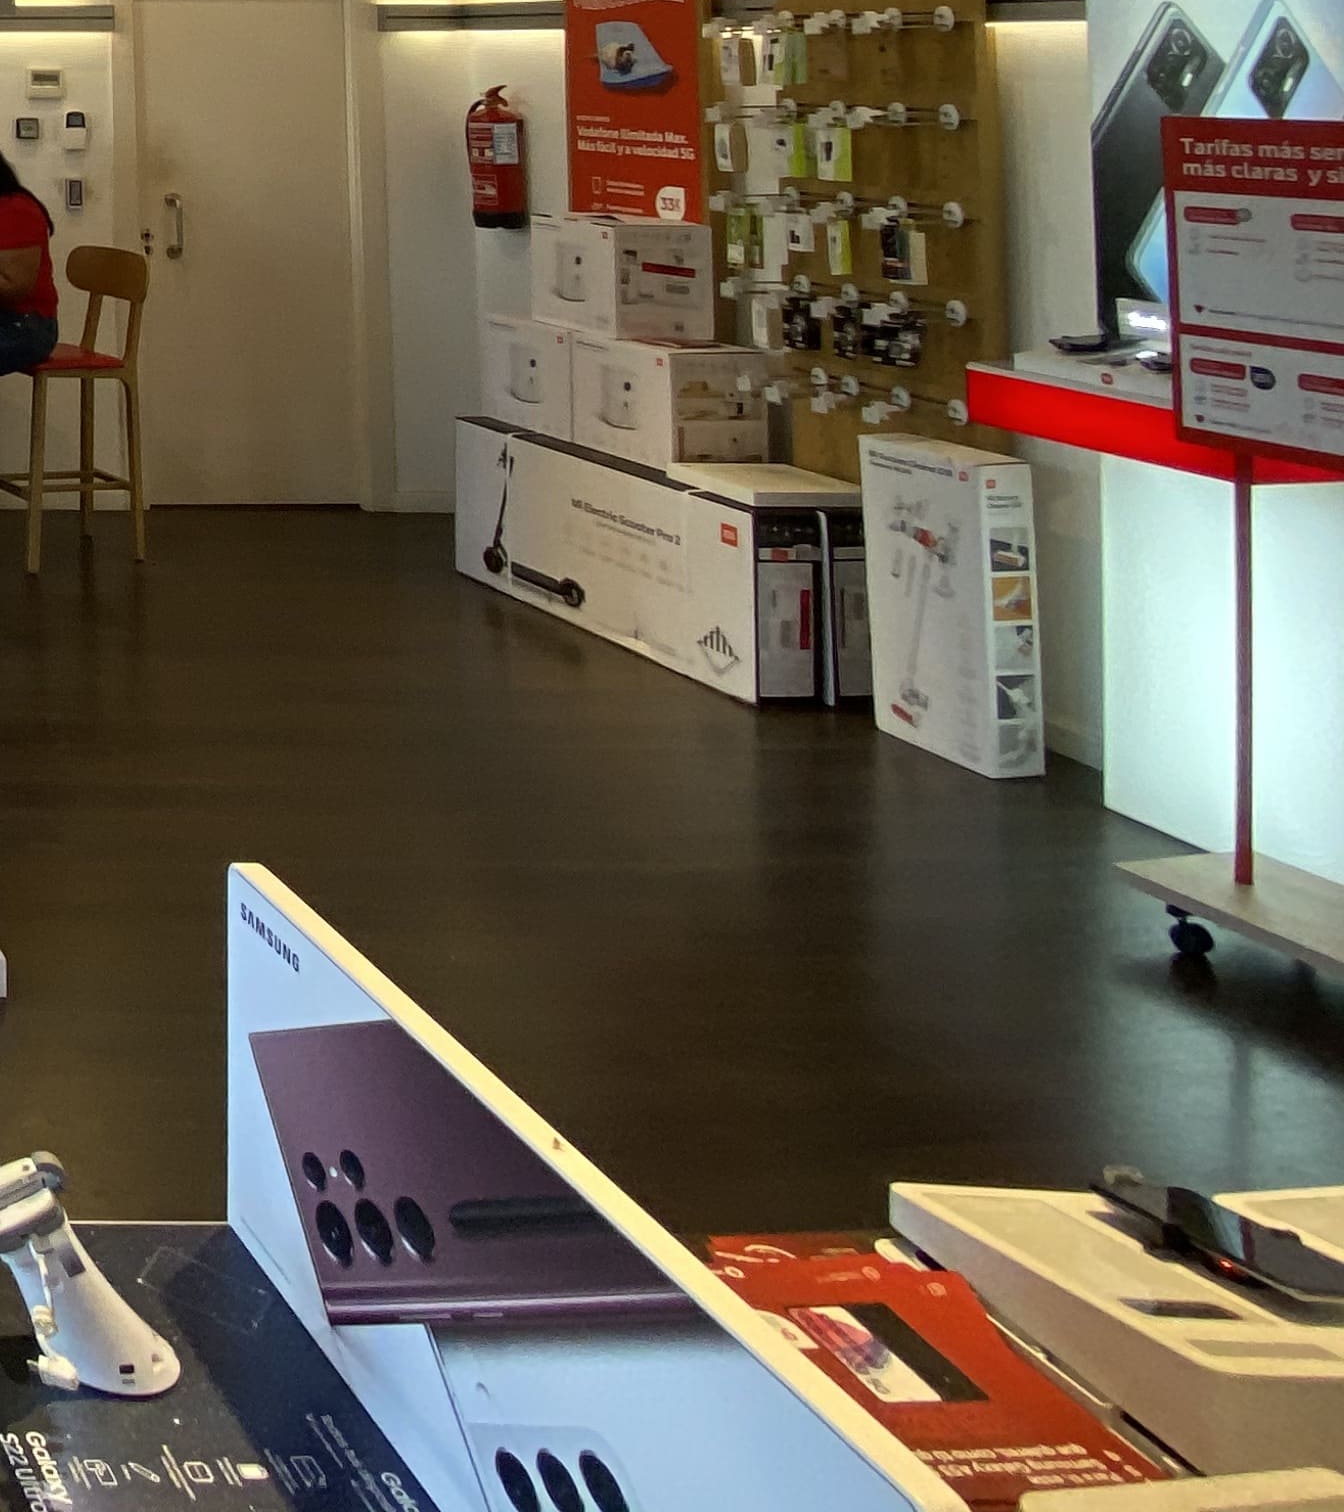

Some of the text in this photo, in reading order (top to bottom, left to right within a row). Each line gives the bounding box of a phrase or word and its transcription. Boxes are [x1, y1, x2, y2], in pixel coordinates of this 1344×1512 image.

[1179, 138, 1254, 157] Tarifas
[1258, 141, 1305, 160] más
[1182, 160, 1226, 177] más
[1231, 164, 1298, 182] claras
[1307, 169, 1322, 186] y
[240, 902, 300, 973] SAMSUNG
[0, 1433, 29, 1466] S22
[25, 1431, 73, 1506] Galaxy
